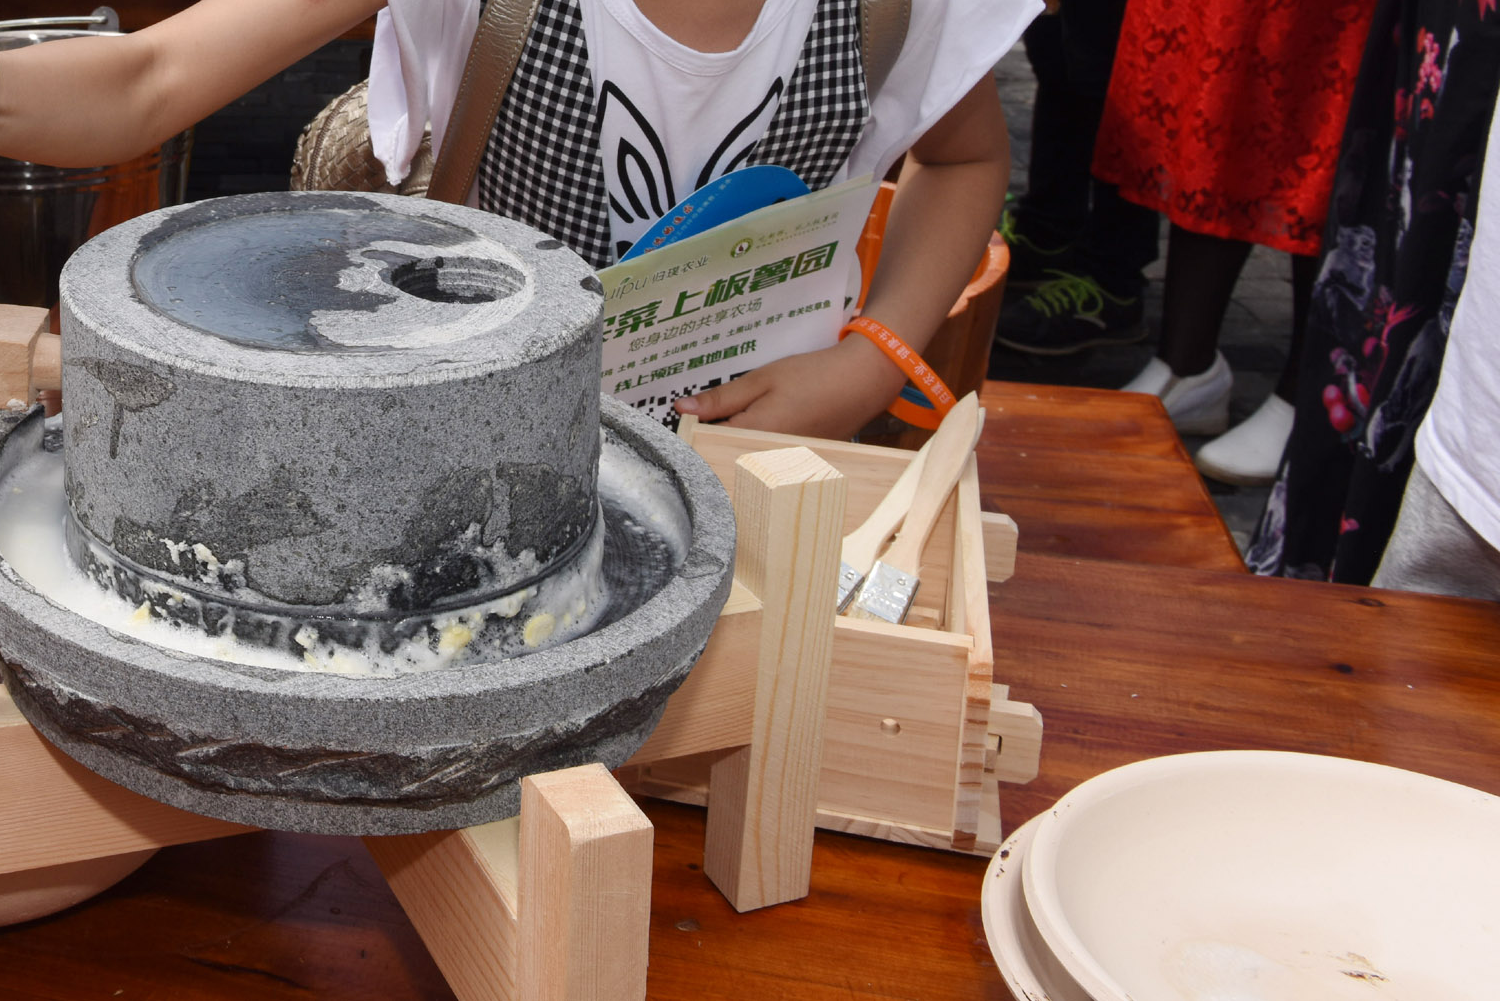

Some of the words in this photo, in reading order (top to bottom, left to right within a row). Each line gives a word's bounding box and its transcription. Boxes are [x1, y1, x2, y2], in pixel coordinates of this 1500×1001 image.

[604, 278, 647, 300] uipu
[627, 298, 763, 353] 您身边的共享农场
[614, 361, 686, 394] 线上预定
[686, 339, 757, 371] 基地直供
